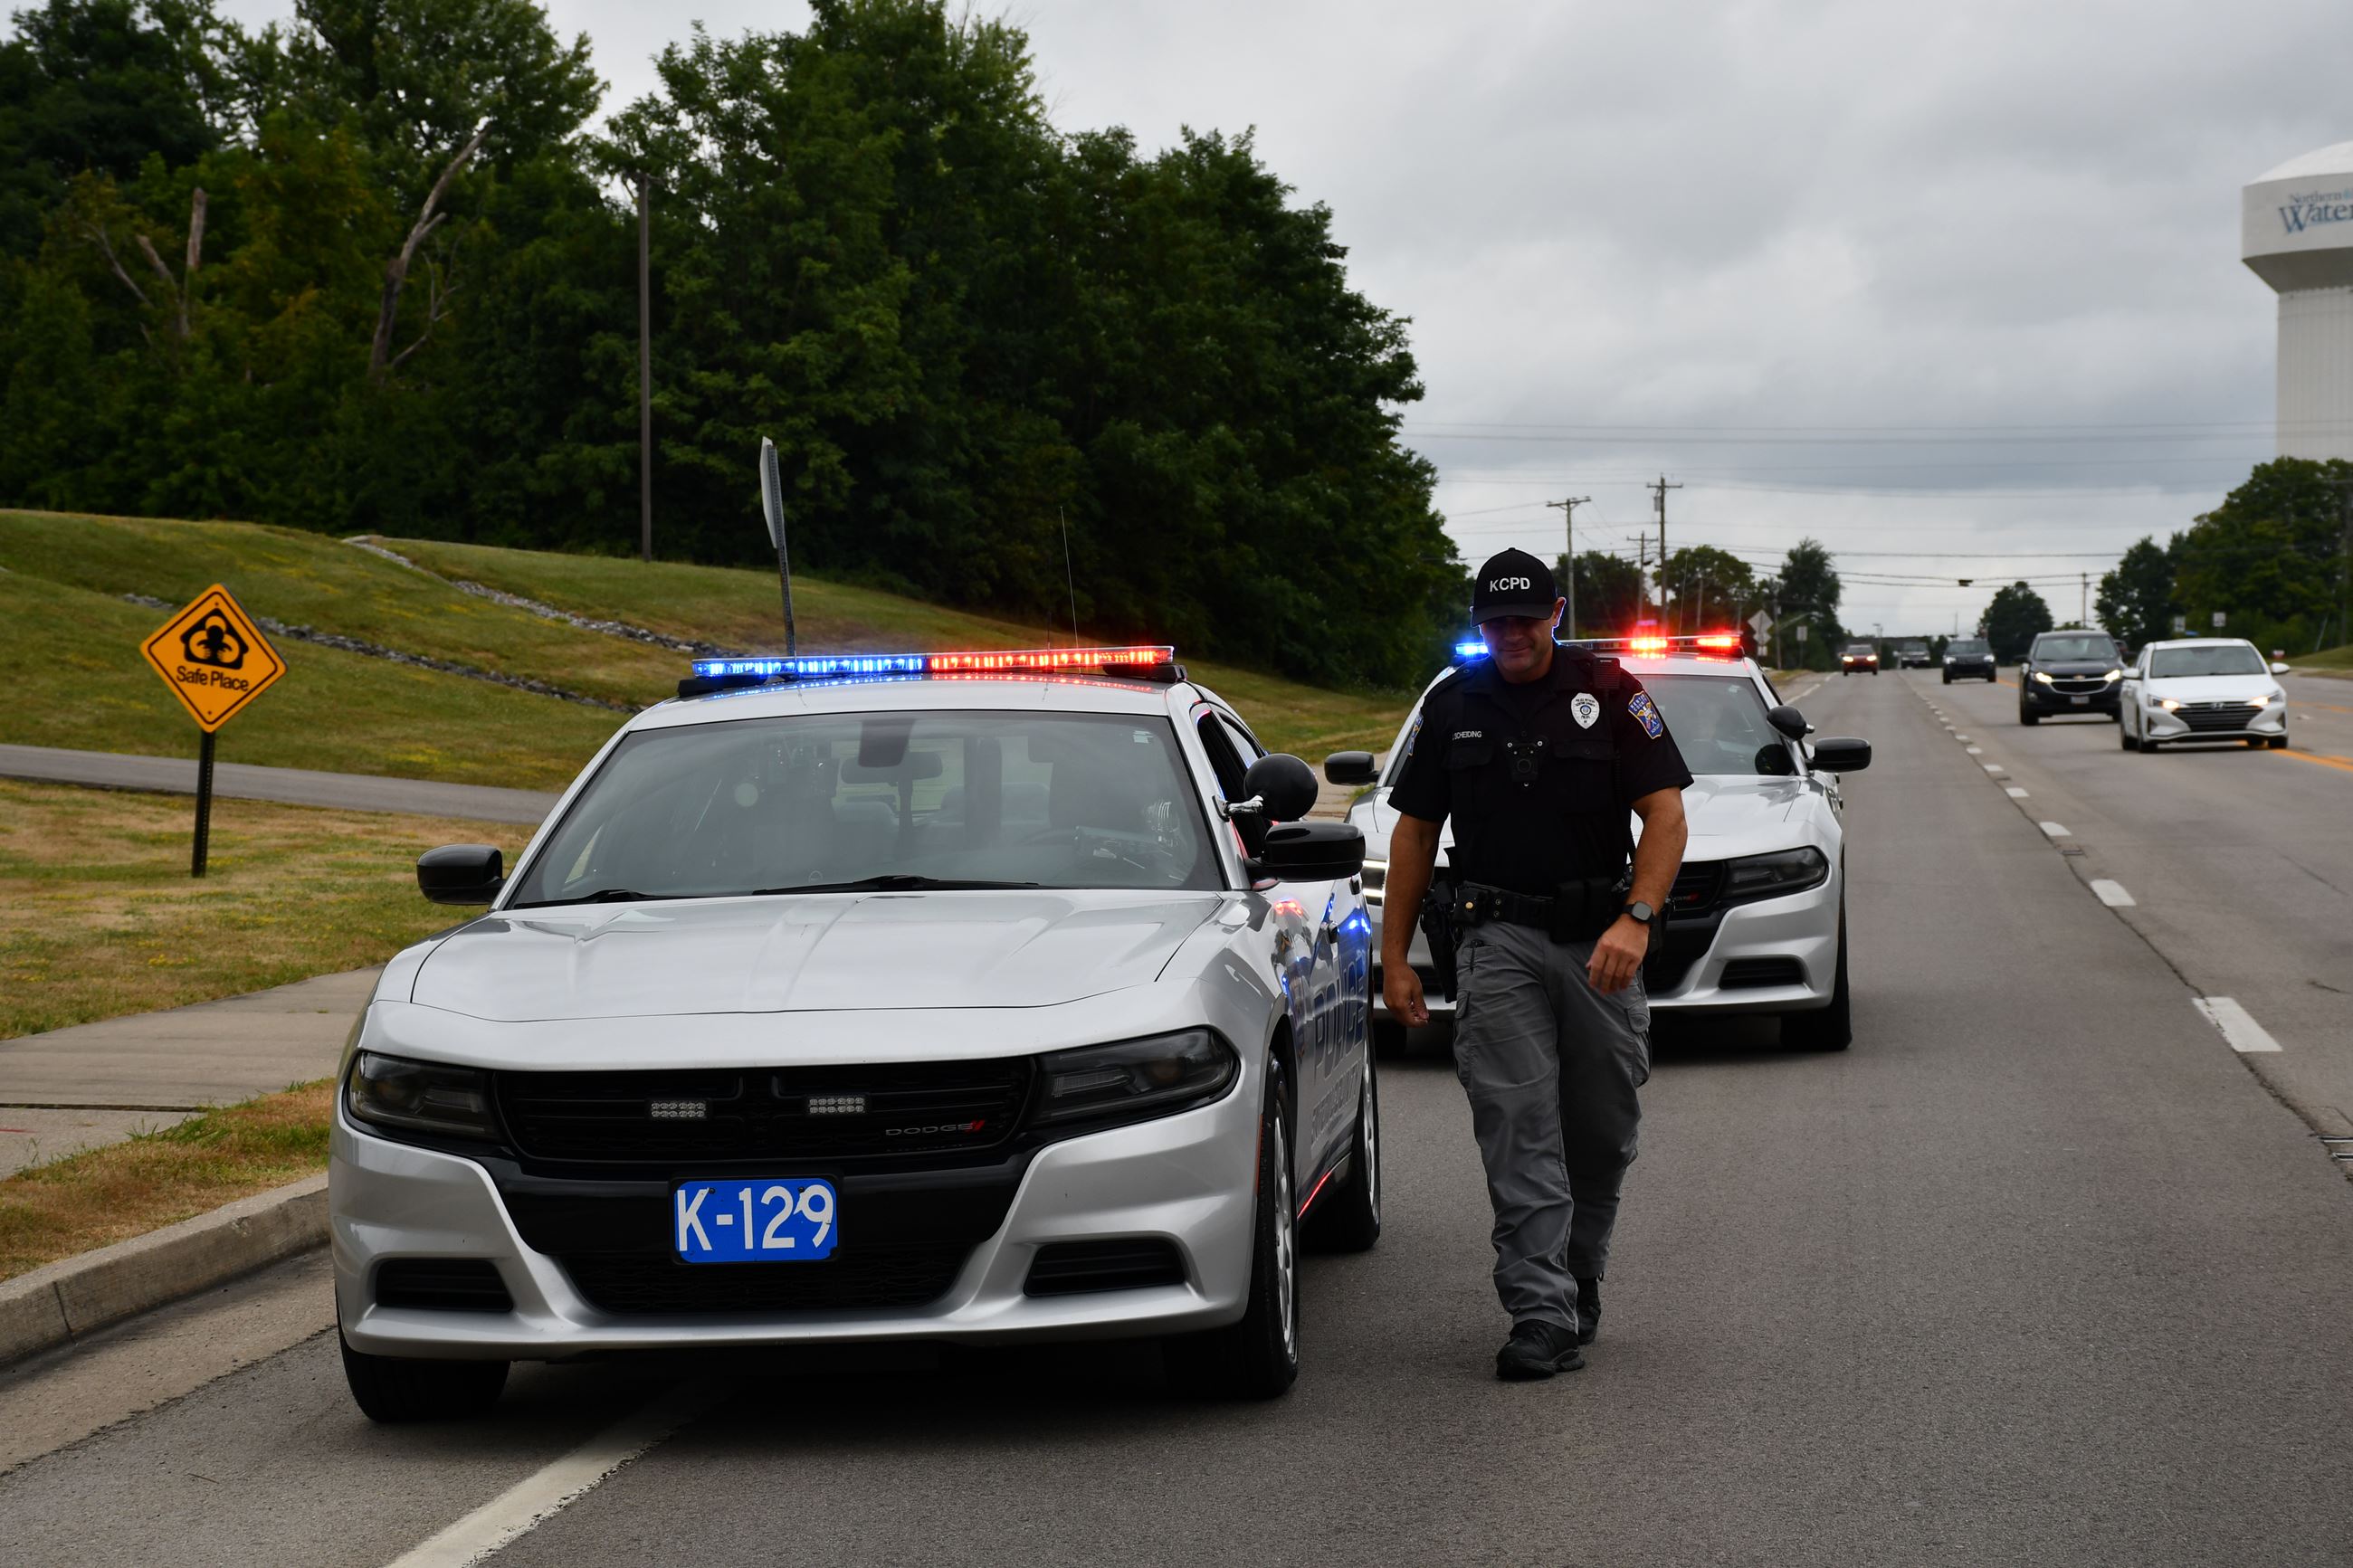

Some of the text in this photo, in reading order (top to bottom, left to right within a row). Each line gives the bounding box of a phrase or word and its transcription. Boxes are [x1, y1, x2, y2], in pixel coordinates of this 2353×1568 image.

[1489, 577, 1530, 593] KCPD
[176, 665, 249, 692] Safe Place
[1314, 948, 1366, 1085] POLICE
[885, 1123, 973, 1136] DODGE
[677, 1183, 834, 1251] K-129
